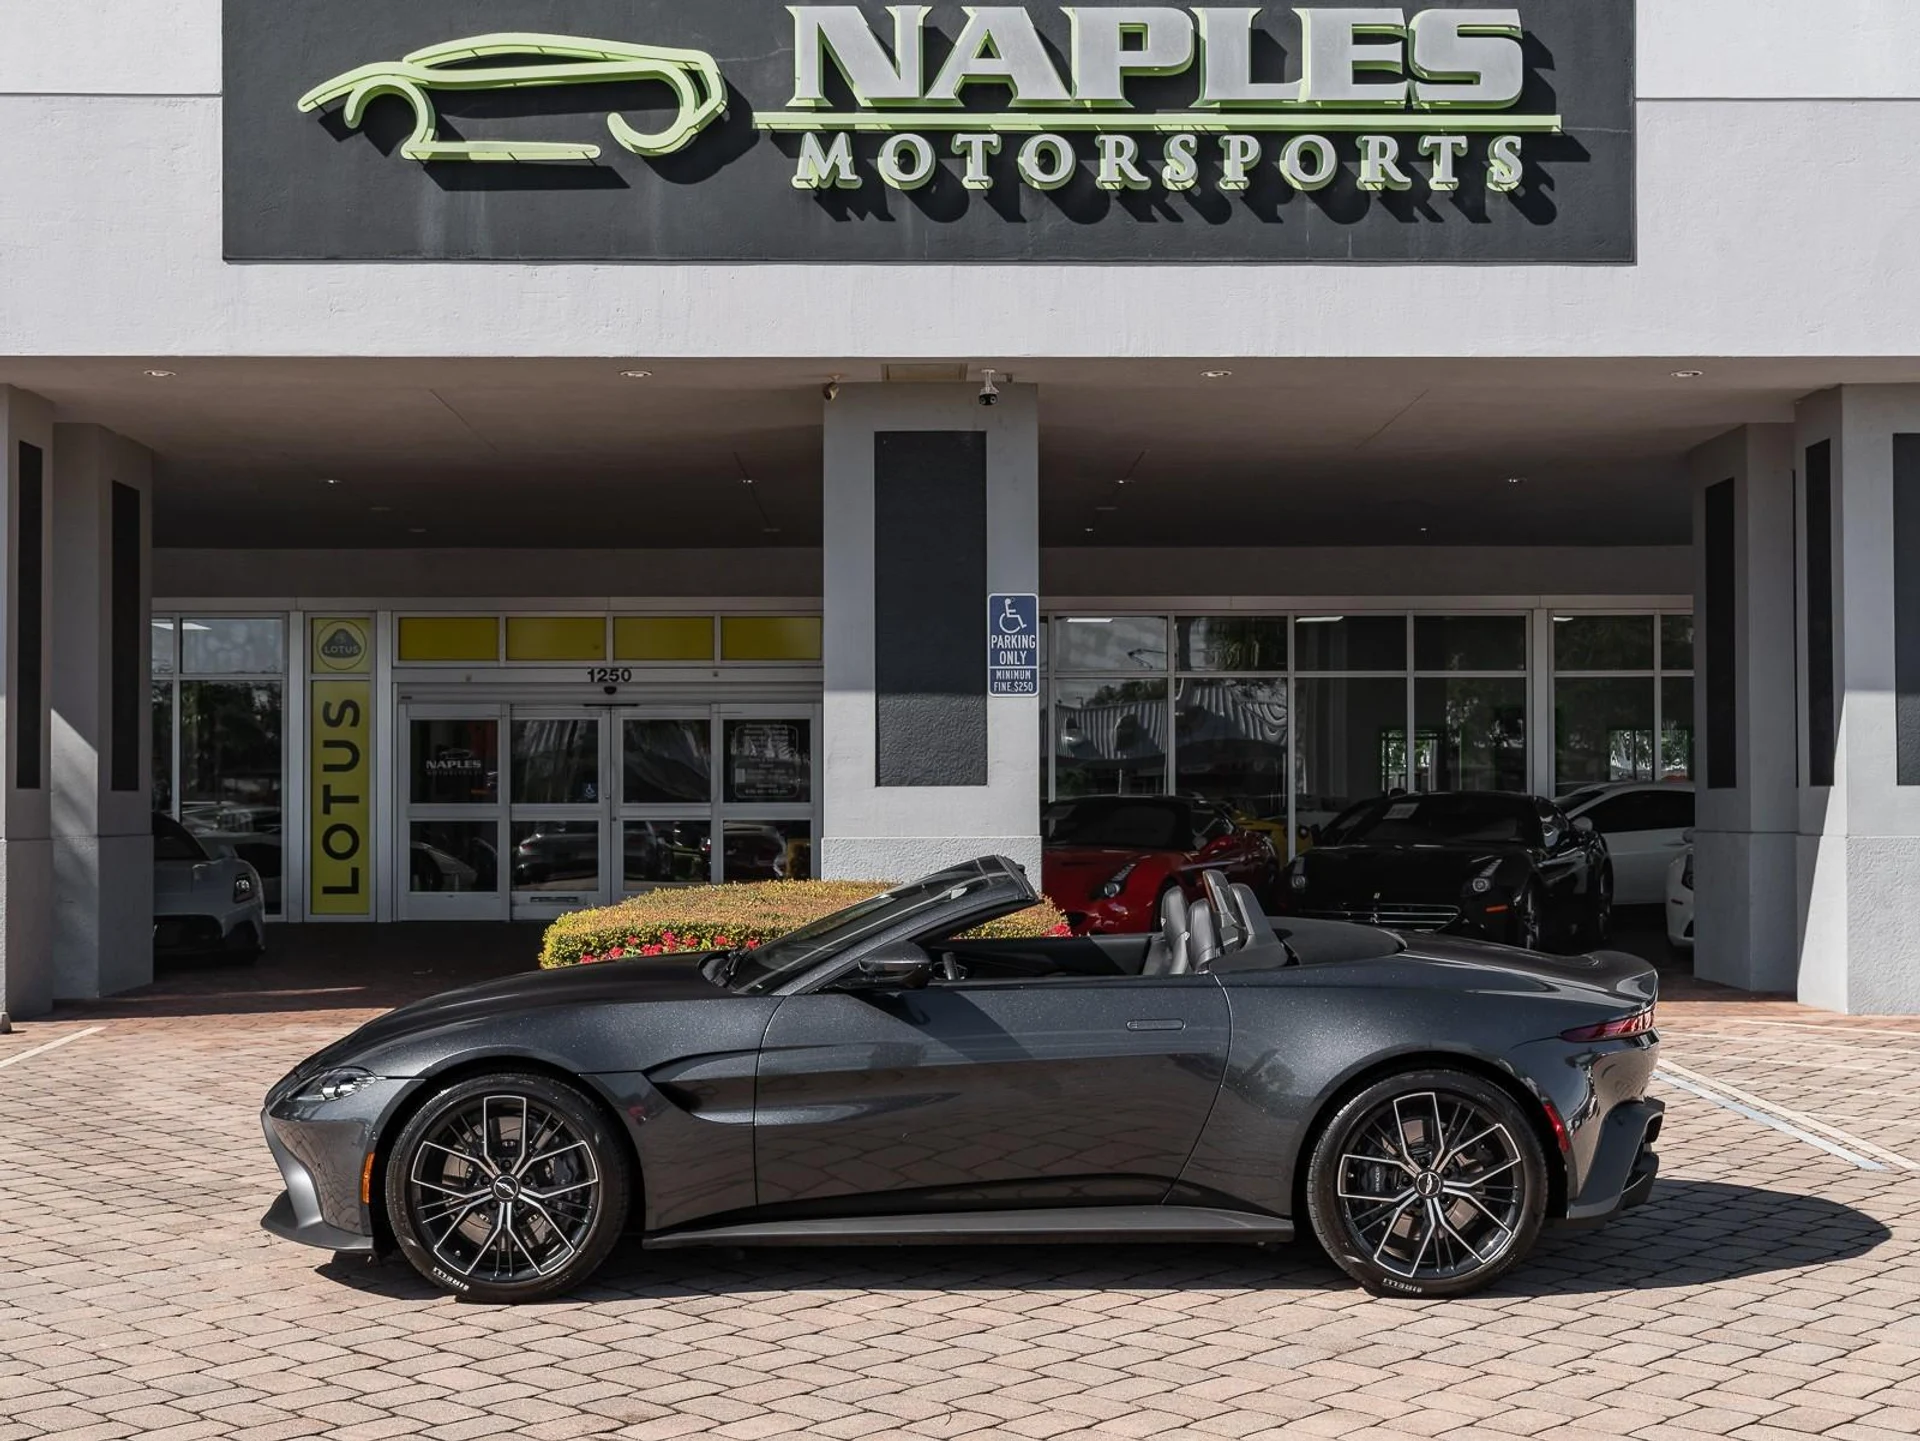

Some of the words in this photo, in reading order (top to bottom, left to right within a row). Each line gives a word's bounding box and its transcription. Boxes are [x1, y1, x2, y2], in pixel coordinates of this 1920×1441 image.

[785, 5, 1523, 109] NAPLES
[791, 131, 1524, 191] MOTORSPORTS
[991, 634, 1036, 649] PARKING
[324, 645, 359, 654] LOTUS
[999, 651, 1027, 665] ONLY
[587, 668, 632, 682] 1250
[996, 670, 1031, 680] MINIMUM
[993, 681, 1011, 692] FINE
[1014, 681, 1034, 693] $250
[425, 760, 482, 769] NAPLES
[322, 699, 360, 895] LOTUS
